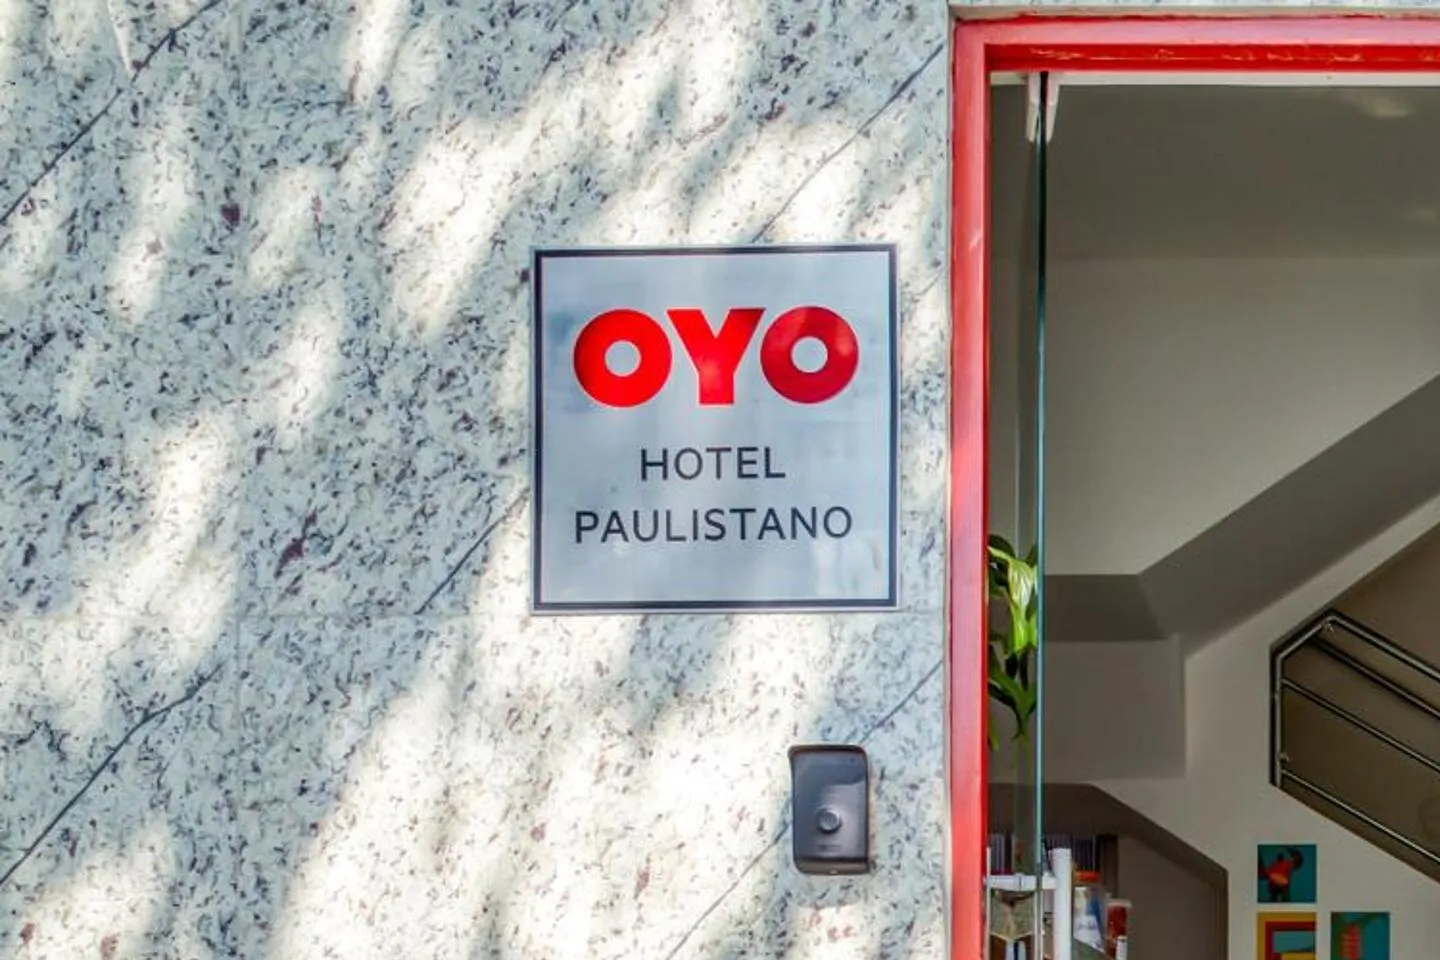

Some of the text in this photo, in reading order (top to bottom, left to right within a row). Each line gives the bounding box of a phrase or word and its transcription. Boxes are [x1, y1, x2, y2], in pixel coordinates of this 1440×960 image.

[573, 305, 860, 408] OYO
[640, 446, 786, 481] HOTEL
[574, 506, 853, 543] PAULISTANO
